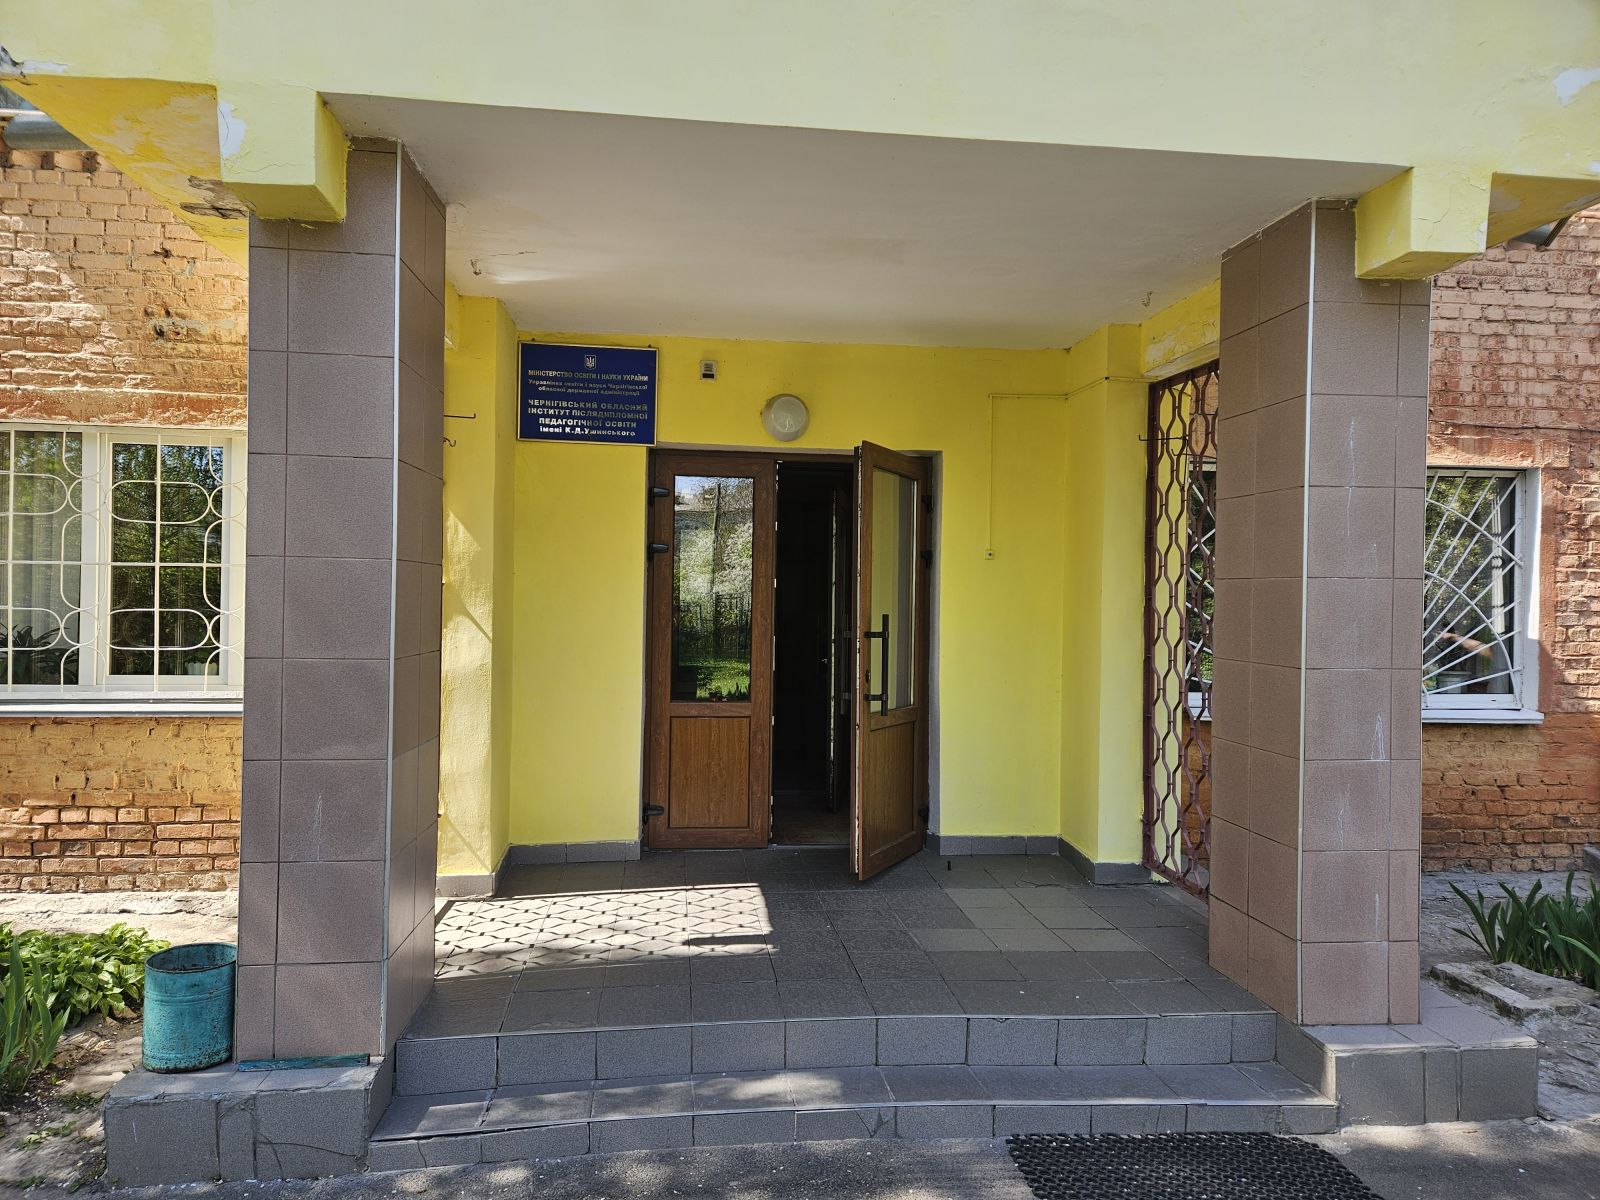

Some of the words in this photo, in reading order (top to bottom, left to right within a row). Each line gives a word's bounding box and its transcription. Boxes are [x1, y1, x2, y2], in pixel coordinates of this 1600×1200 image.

[528, 370, 573, 378] МІНІСТЕРСТВО
[623, 373, 648, 381] УКРАЇНИ
[528, 399, 597, 409] ЧЕРНІГІВСЬКИЙ
[601, 402, 648, 411] ОБЛАСНИЙ
[528, 407, 570, 416] ІНСТИТУТ
[572, 410, 648, 420] ПІСЛЯДИПЛОМНОЇ
[539, 417, 602, 427] ПЕДАГОГІЧНОЇ
[605, 420, 637, 428] ОСВІТИ
[540, 425, 562, 433] імені
